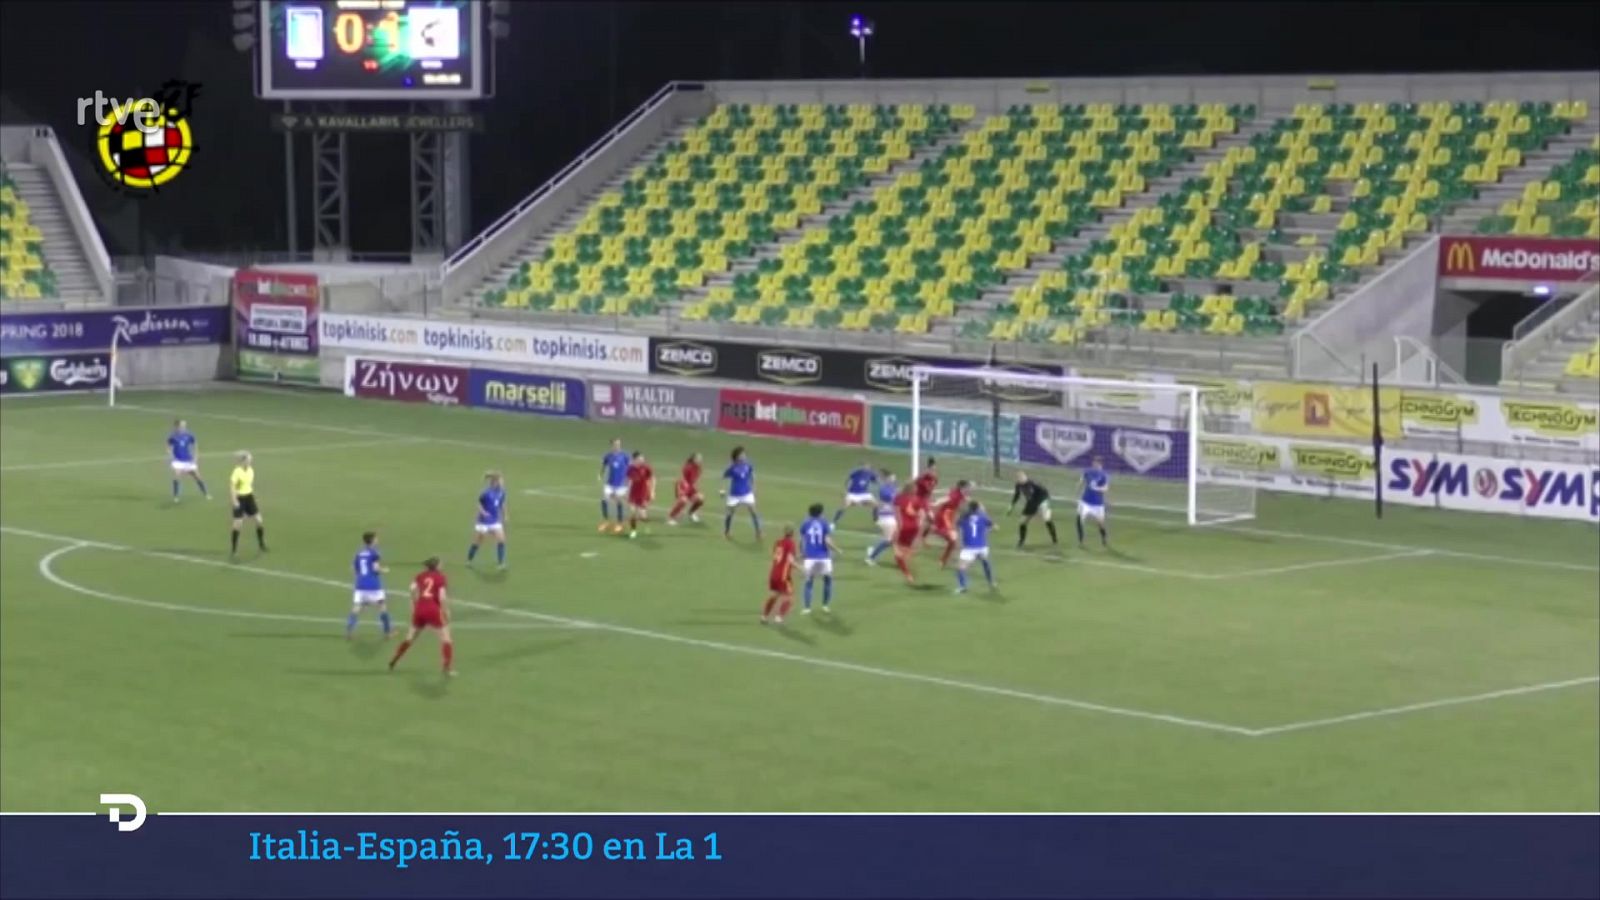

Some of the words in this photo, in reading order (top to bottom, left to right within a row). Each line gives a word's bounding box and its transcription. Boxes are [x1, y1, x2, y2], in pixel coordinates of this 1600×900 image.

[52, 322, 84, 338] 2018
[111, 311, 191, 343] Radisson
[322, 318, 418, 344] topkinisis.com
[423, 327, 528, 352] topkinisis.com
[532, 337, 644, 362] topkinisis.com
[659, 347, 714, 366] ZEMCO
[761, 355, 818, 374] ZEMCO
[623, 384, 676, 404] WEALTH
[623, 401, 712, 425] MANAGEMENT
[881, 412, 978, 449] EuoLife
[1389, 458, 1469, 497] SYM
[1500, 467, 1586, 507] SYM
[424, 578, 434, 597] 2
